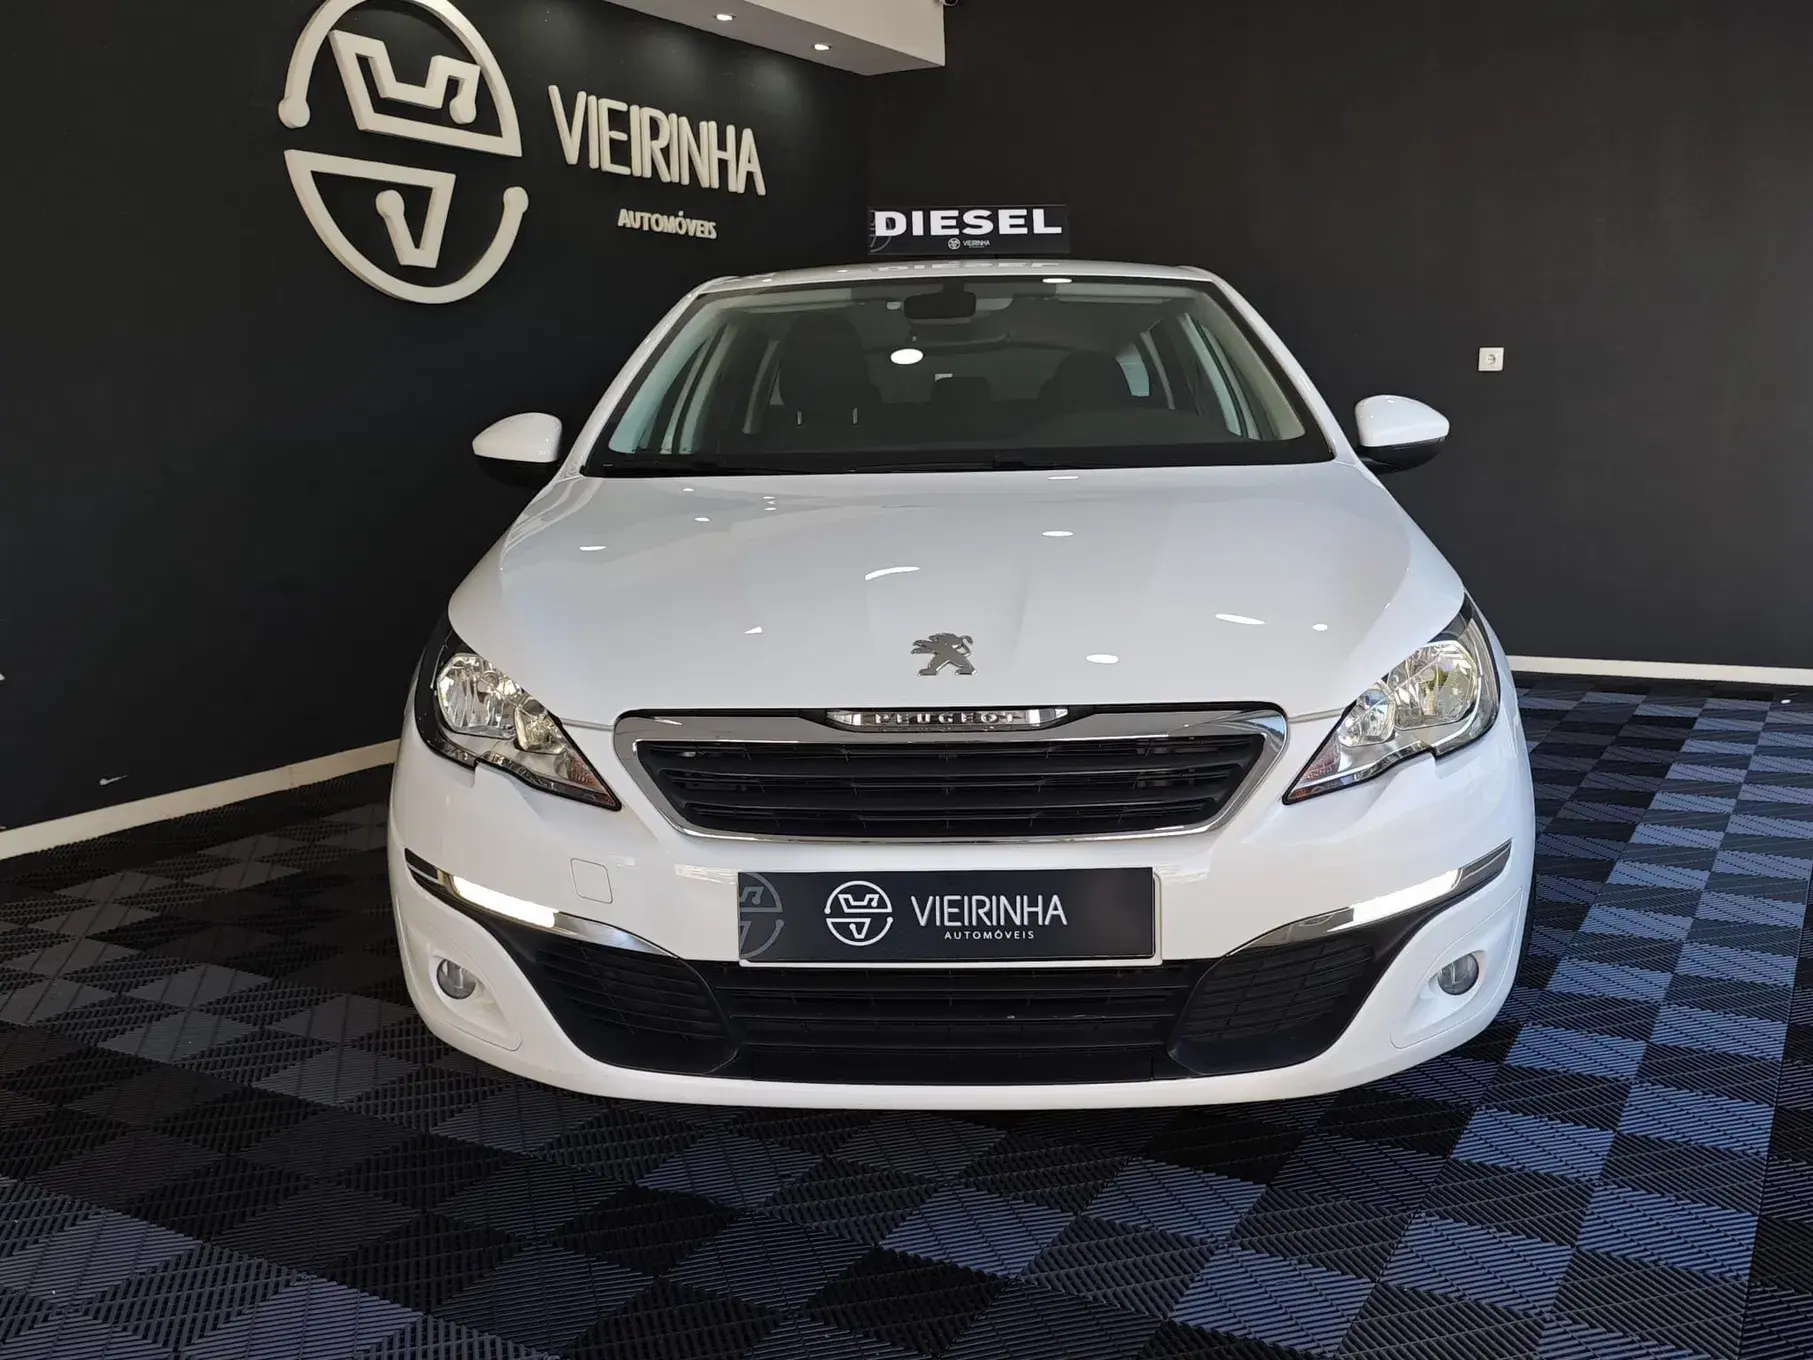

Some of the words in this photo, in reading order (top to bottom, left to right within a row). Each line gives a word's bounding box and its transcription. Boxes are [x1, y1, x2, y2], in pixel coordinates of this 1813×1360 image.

[548, 84, 766, 196] VIEIRINHA
[617, 209, 717, 239] AUTOMÓVEIS
[875, 208, 1062, 236] DIESEL
[910, 894, 1068, 927] VIEIRINHA
[944, 929, 1035, 941] AUTOMÓVEIS
